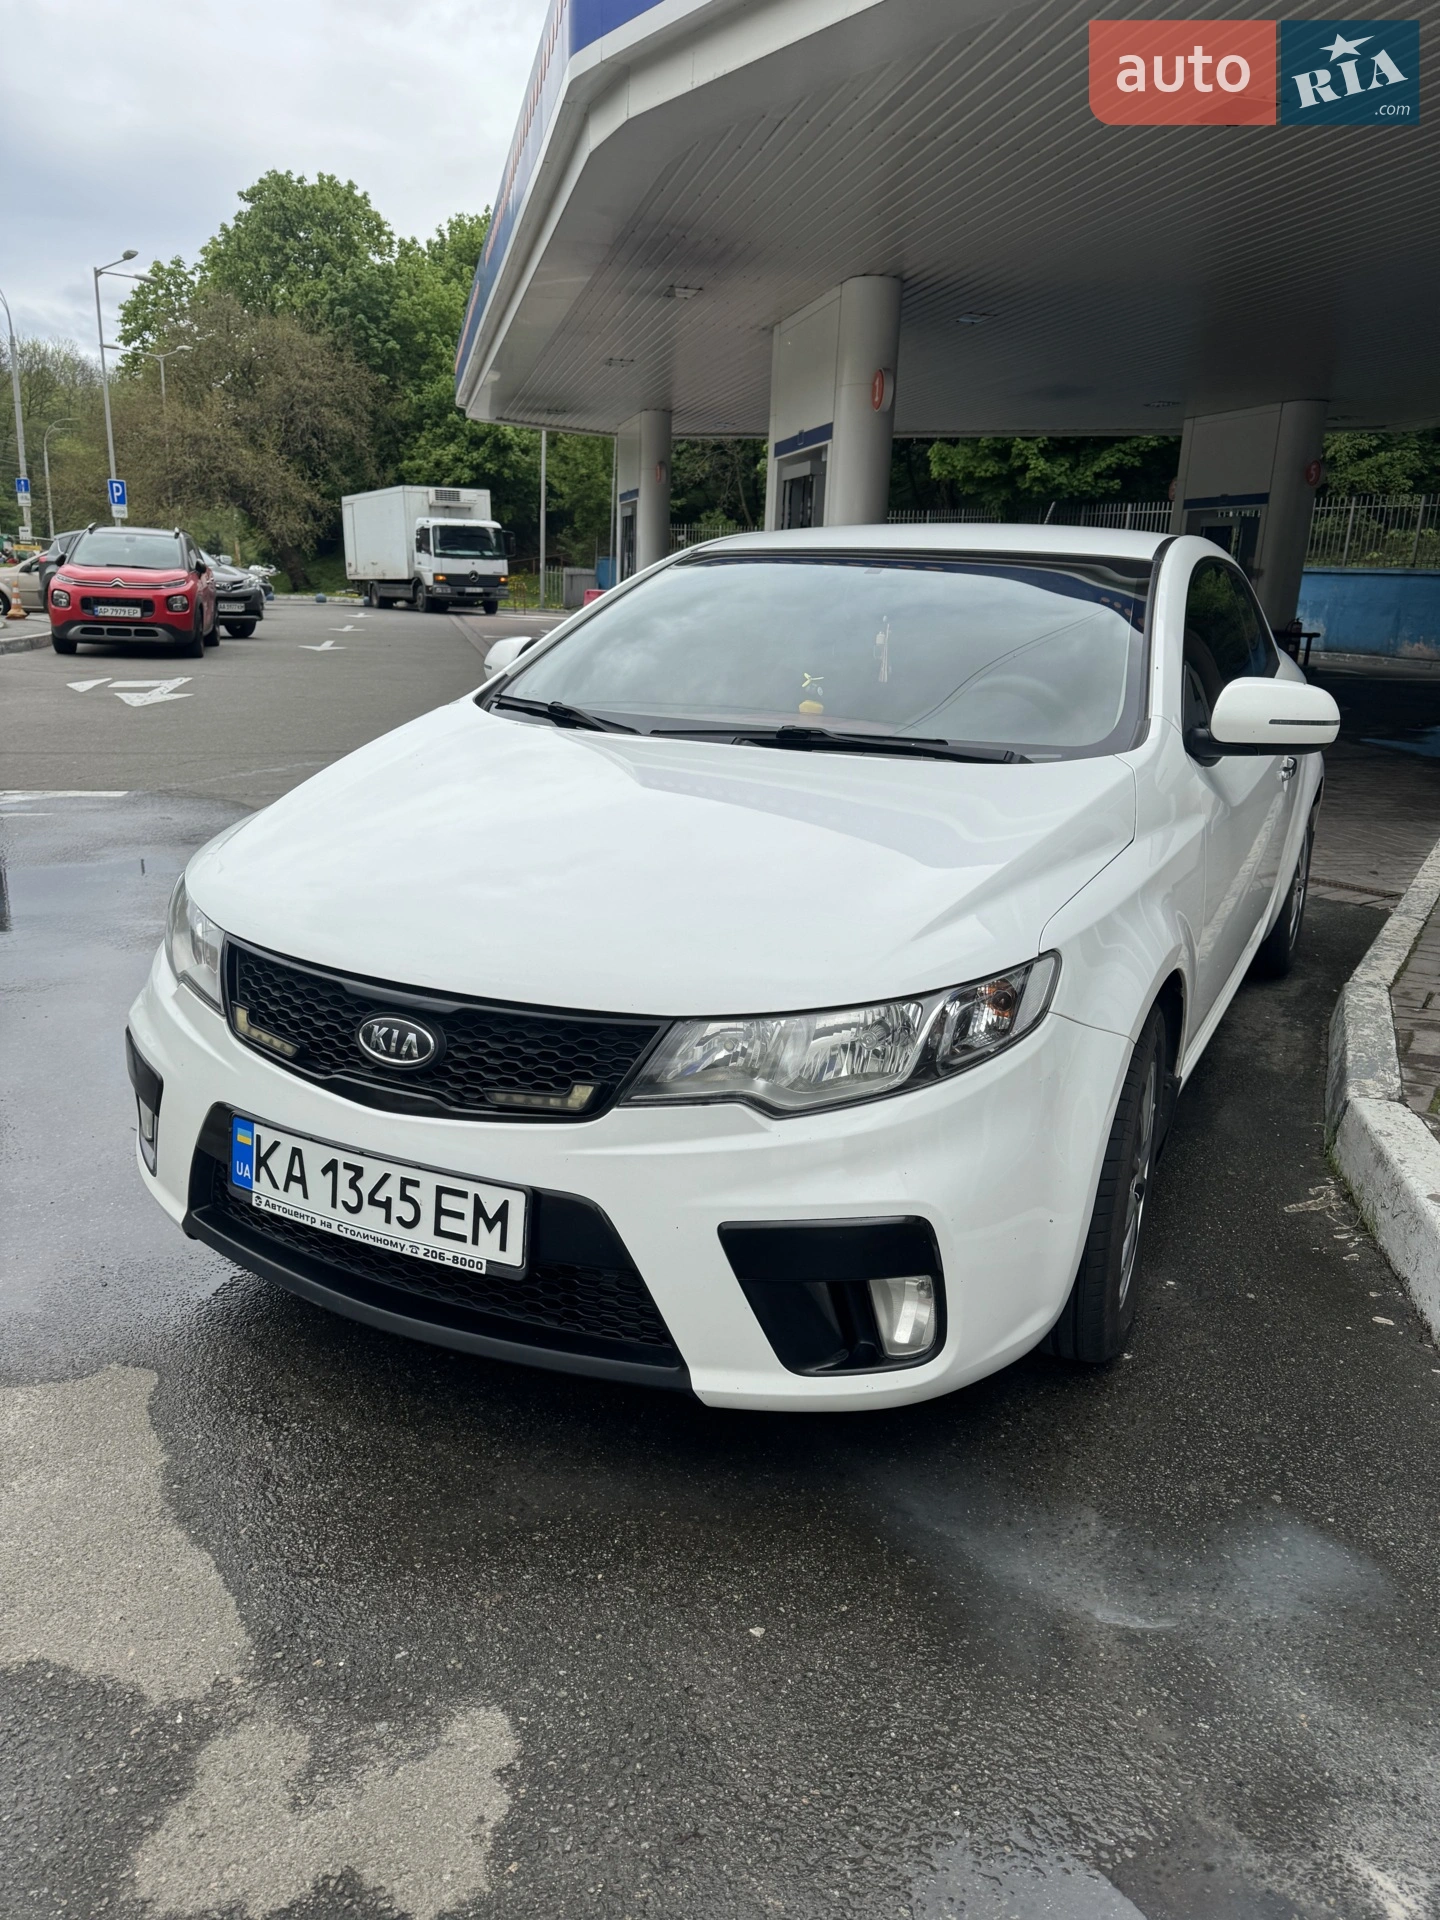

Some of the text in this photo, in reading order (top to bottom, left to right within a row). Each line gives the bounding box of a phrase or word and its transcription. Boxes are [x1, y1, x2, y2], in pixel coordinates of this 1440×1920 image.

[112, 482, 123, 503] P
[127, 608, 138, 616] EP
[370, 1024, 419, 1058] KIA
[236, 1161, 251, 1178] UA
[255, 1134, 510, 1252] KA 1345 EM
[264, 1199, 483, 1272] Автоцентр на Столичному 206-8000
